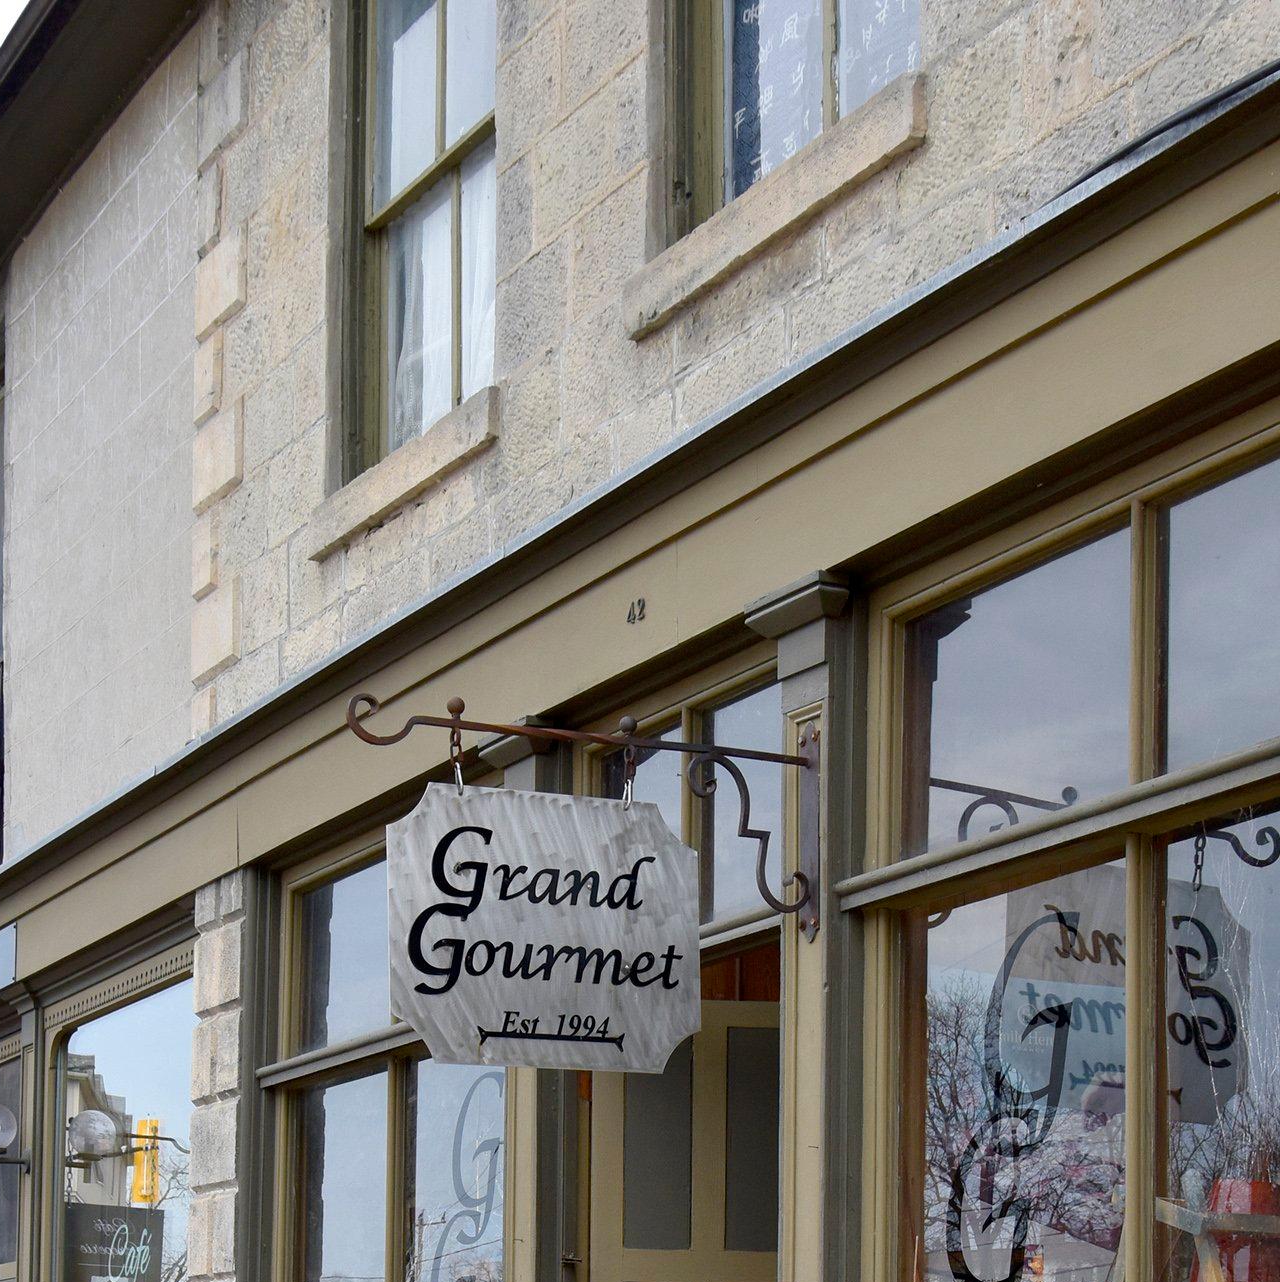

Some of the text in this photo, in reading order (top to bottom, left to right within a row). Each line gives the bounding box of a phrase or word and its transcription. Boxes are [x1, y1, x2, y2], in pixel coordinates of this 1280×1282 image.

[431, 825, 656, 918] Grand
[407, 902, 683, 995] Gourmet
[502, 1010, 610, 1039] Est 1994
